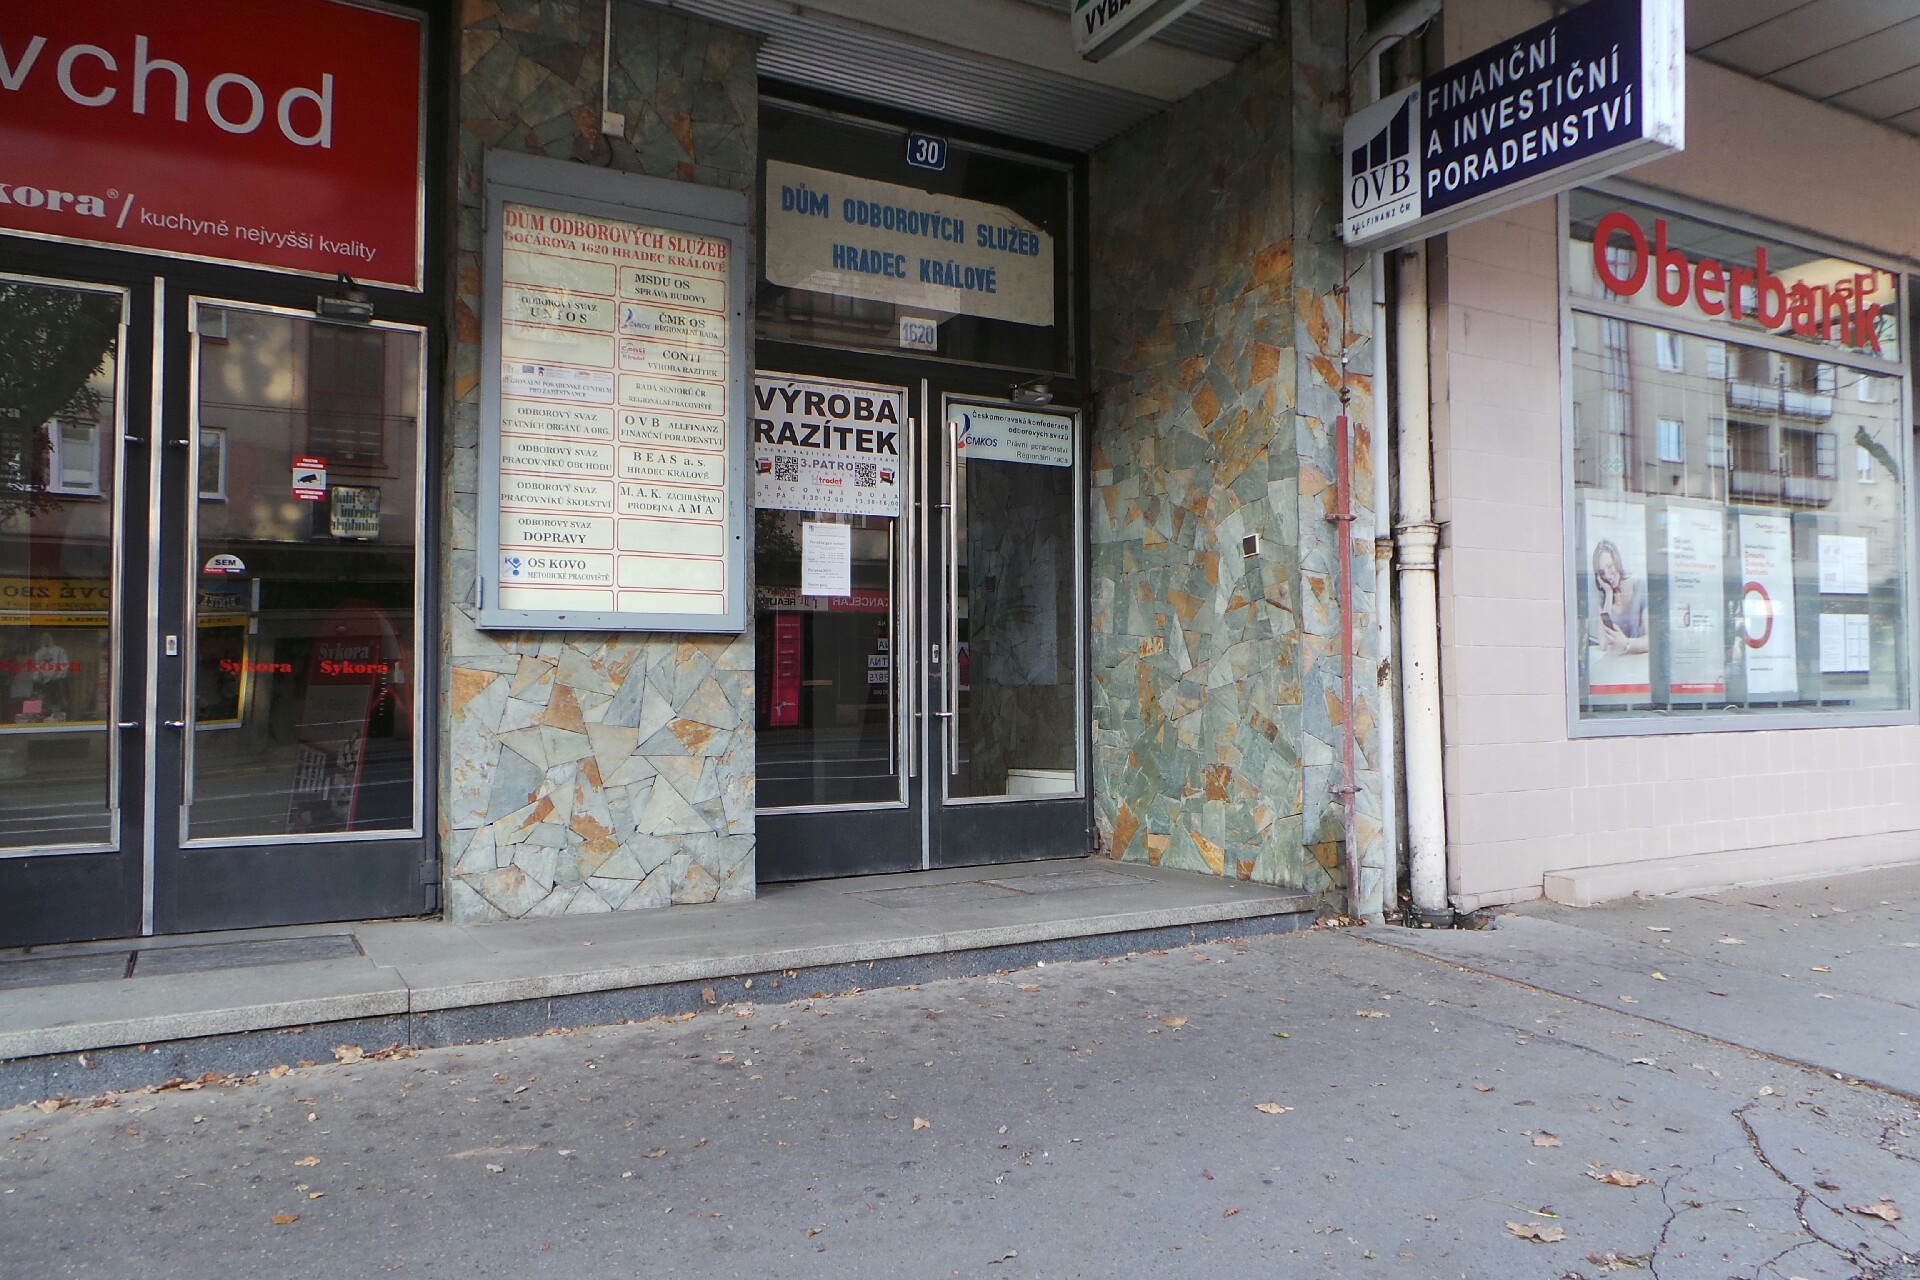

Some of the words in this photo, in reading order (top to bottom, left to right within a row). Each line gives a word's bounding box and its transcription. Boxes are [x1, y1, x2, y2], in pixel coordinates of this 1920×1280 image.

[1428, 27, 1557, 119] FINANČNÍ
[0, 34, 333, 149] vchod
[1427, 129, 1443, 159] A
[1454, 43, 1620, 149] INVESTIČNÍ
[1428, 84, 1633, 199] PORADENSTVÍ
[916, 138, 940, 164] 30
[1352, 159, 1410, 209] OVB
[1400, 202, 1411, 214] ČR
[781, 182, 830, 218] DŮM
[843, 198, 965, 244] ODBOROVÝCH
[976, 224, 1040, 256] SLUŽEB
[140, 208, 229, 236] kuchyně
[319, 235, 377, 262] kvality
[549, 217, 664, 250] ODBOROVÝCH
[668, 236, 727, 259] SLUŽEB
[504, 231, 577, 250] GOČÁROVA
[582, 242, 609, 255] 1620
[613, 247, 665, 263] HRADEC
[668, 256, 726, 273] KRÁLOVÉ
[832, 243, 906, 279] HRADEC
[919, 258, 997, 293] KRÁLOVÉ
[635, 274, 671, 287] MSDU
[674, 279, 690, 289] OS
[1593, 211, 1882, 352] Oberbank
[635, 287, 668, 299] SPRÁVA
[670, 293, 707, 304] BUDOVY
[574, 303, 598, 312] SVAZ
[659, 312, 686, 326] ČMK
[689, 317, 706, 328] OS
[699, 330, 719, 340] RADA
[903, 322, 934, 345] 1620
[662, 350, 702, 363] CONTI
[648, 362, 680, 373] VÝROBA
[636, 382, 658, 393] RADA
[659, 385, 693, 395] SENIORŮ
[694, 388, 706, 397] ČR
[754, 383, 898, 424] VÝROBA
[574, 413, 598, 421] SVAZ
[972, 410, 1028, 425] Českomoravská
[1028, 417, 1069, 431] konfederace
[591, 427, 610, 435] ORG.
[621, 429, 662, 439] FINANČNÍ
[668, 422, 719, 433] ALLFINANZ
[1008, 427, 1048, 439] odborových
[754, 420, 898, 455] RAZÍTEK
[966, 433, 998, 447] ČMKOS
[518, 444, 572, 455] ODBOROVÝ
[574, 449, 599, 458] SVAZ
[567, 461, 612, 471] OBCHODU
[627, 466, 665, 476] HRADEC
[517, 481, 571, 493] ODBOROVÝ
[573, 486, 598, 494] SVAZ
[819, 477, 843, 485] trodat
[628, 502, 673, 512] PRODEJNA
[570, 521, 592, 529] SVAZ
[523, 531, 586, 544] DOPRAVY
[528, 557, 546, 568] OS
[549, 559, 586, 570] KOVO
[219, 659, 293, 676] Sykora
[320, 659, 388, 676] Sykora
